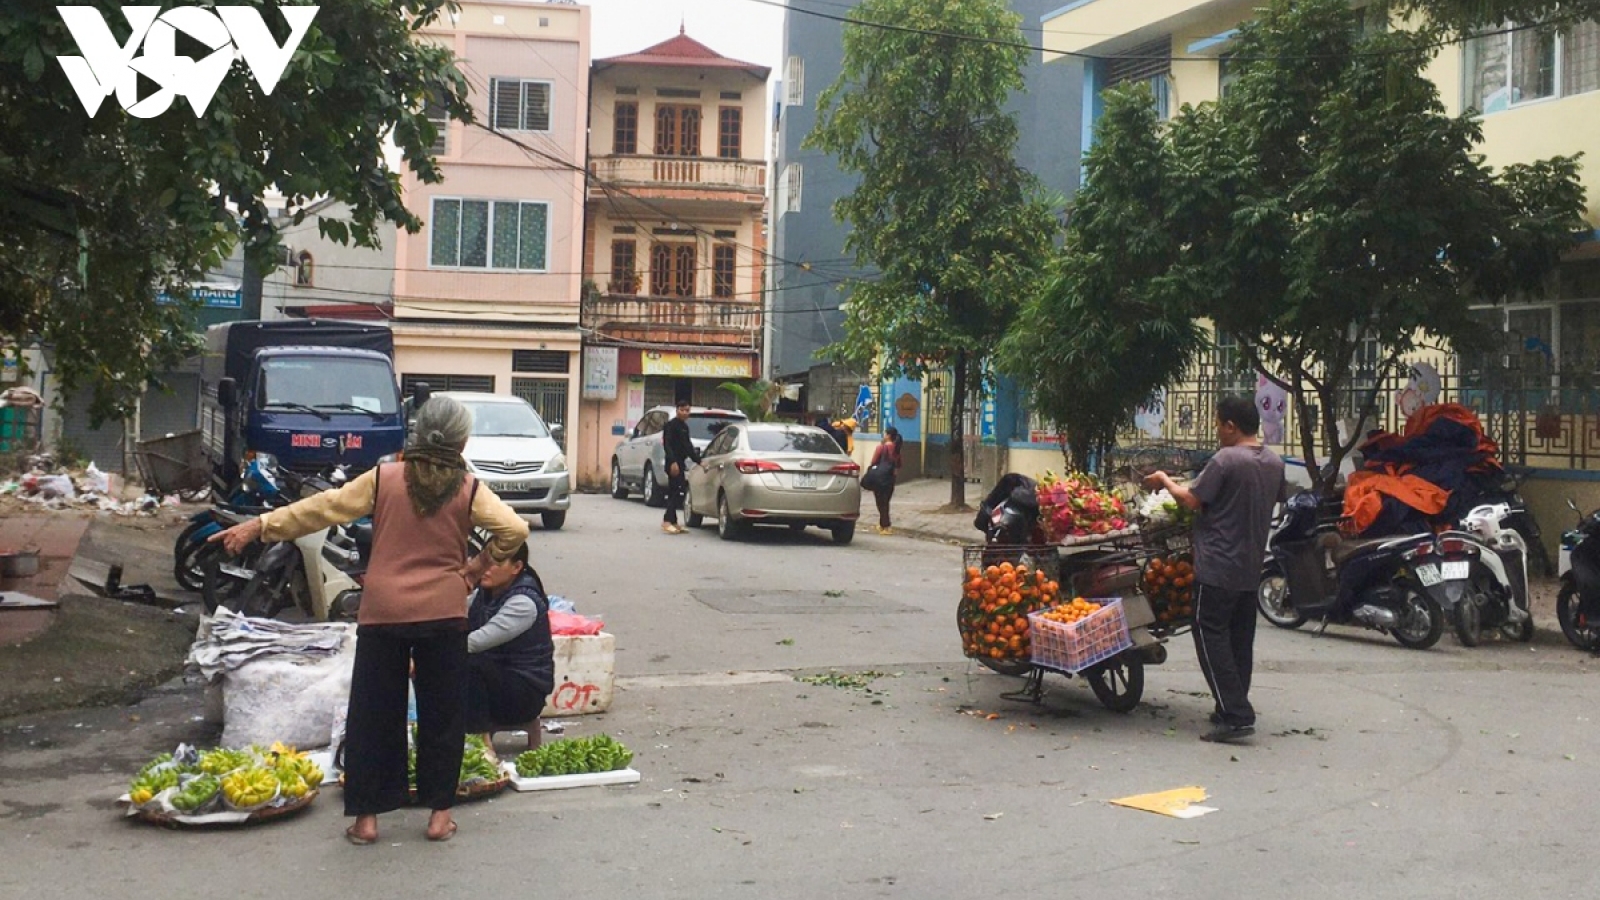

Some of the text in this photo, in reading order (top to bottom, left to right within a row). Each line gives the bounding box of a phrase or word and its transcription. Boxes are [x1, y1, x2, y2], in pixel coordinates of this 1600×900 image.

[715, 364, 748, 376] NGAN
[291, 433, 321, 448] MINH
[552, 681, 600, 710] QT
